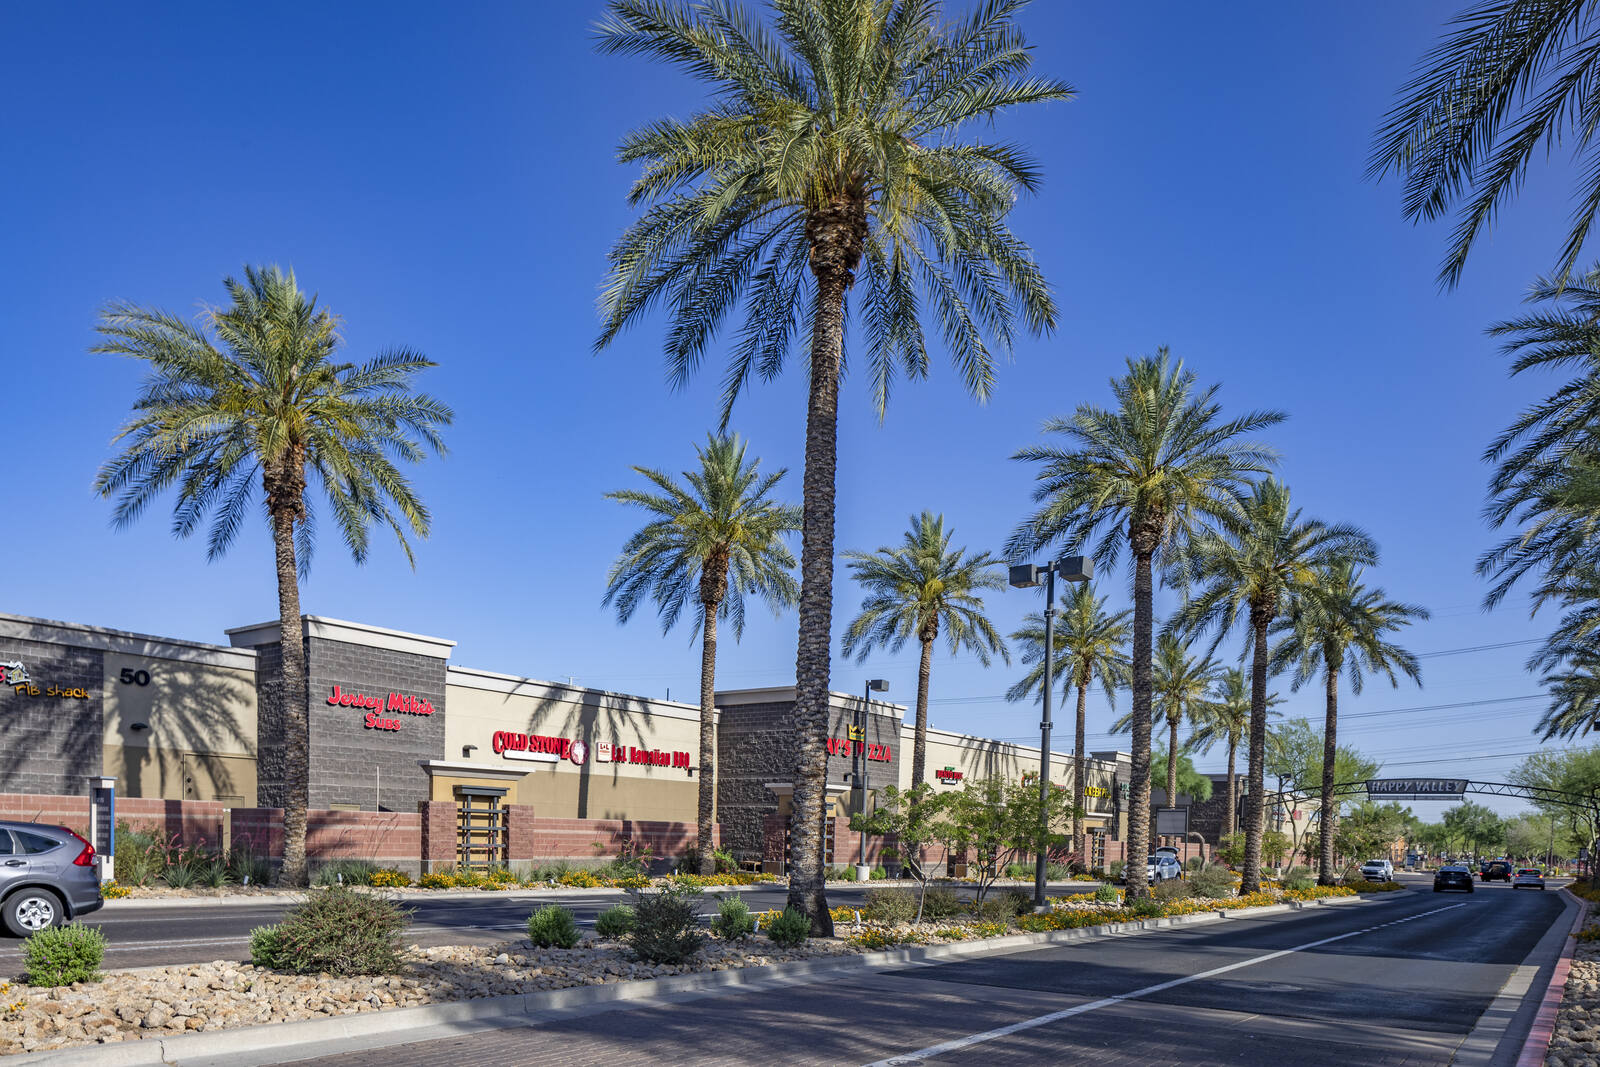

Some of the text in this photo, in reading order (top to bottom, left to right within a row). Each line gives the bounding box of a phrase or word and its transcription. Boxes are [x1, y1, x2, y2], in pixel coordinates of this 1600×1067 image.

[120, 668, 150, 686] 50
[327, 685, 436, 716] Jersey Mike's
[493, 730, 571, 759] COLD STONE
[826, 737, 892, 762] AY'S PZZA
[629, 746, 671, 766] Hawaiian
[673, 751, 690, 769] BBQ
[1371, 781, 1462, 792] HAPPY VALLEY
